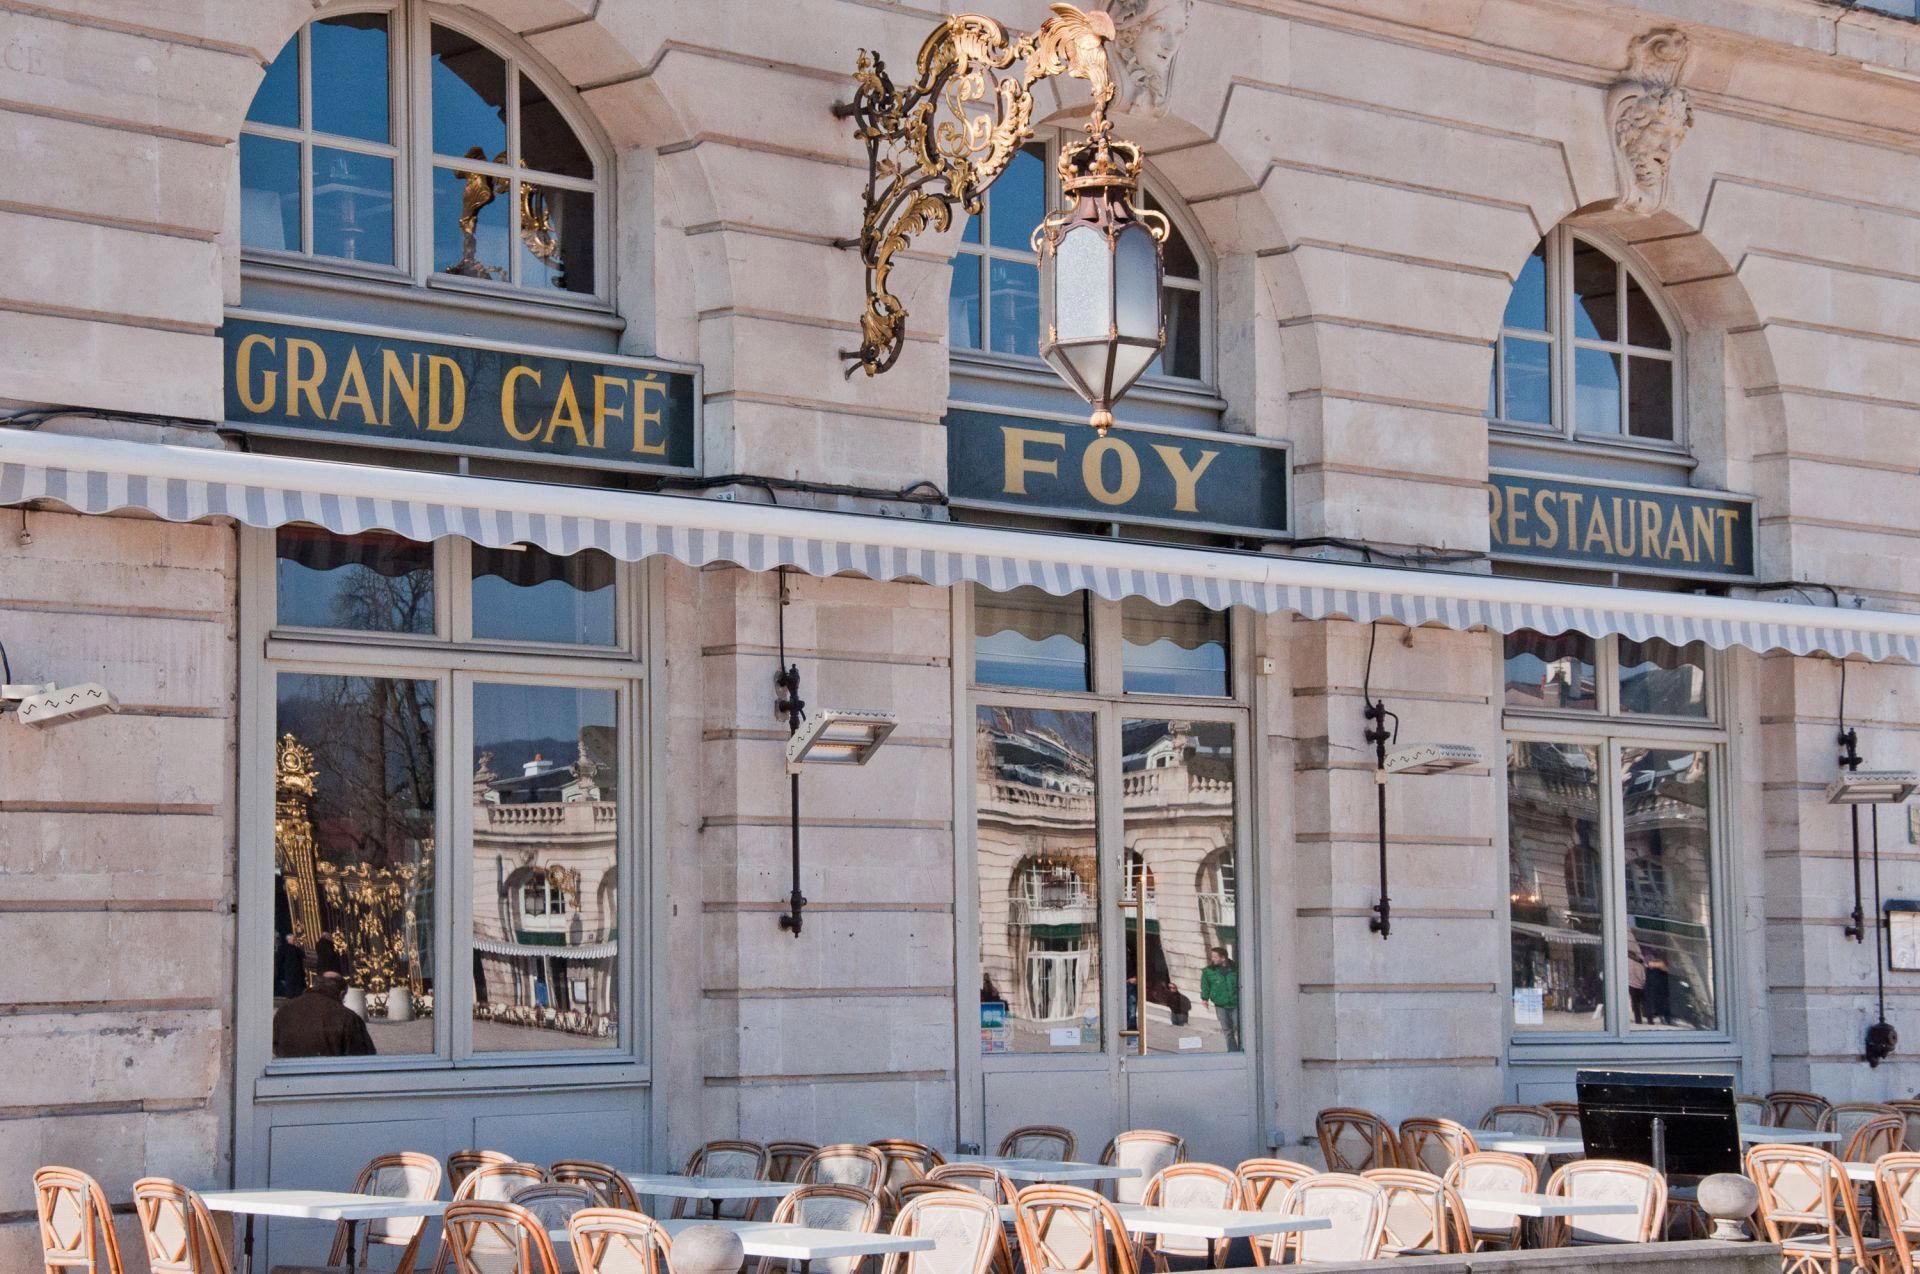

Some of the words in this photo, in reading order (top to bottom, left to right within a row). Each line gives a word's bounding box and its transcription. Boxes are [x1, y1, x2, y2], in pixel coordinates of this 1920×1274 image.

[235, 333, 466, 432] GRAND
[501, 366, 667, 456] CAFÉ
[1000, 426, 1220, 513] FOY
